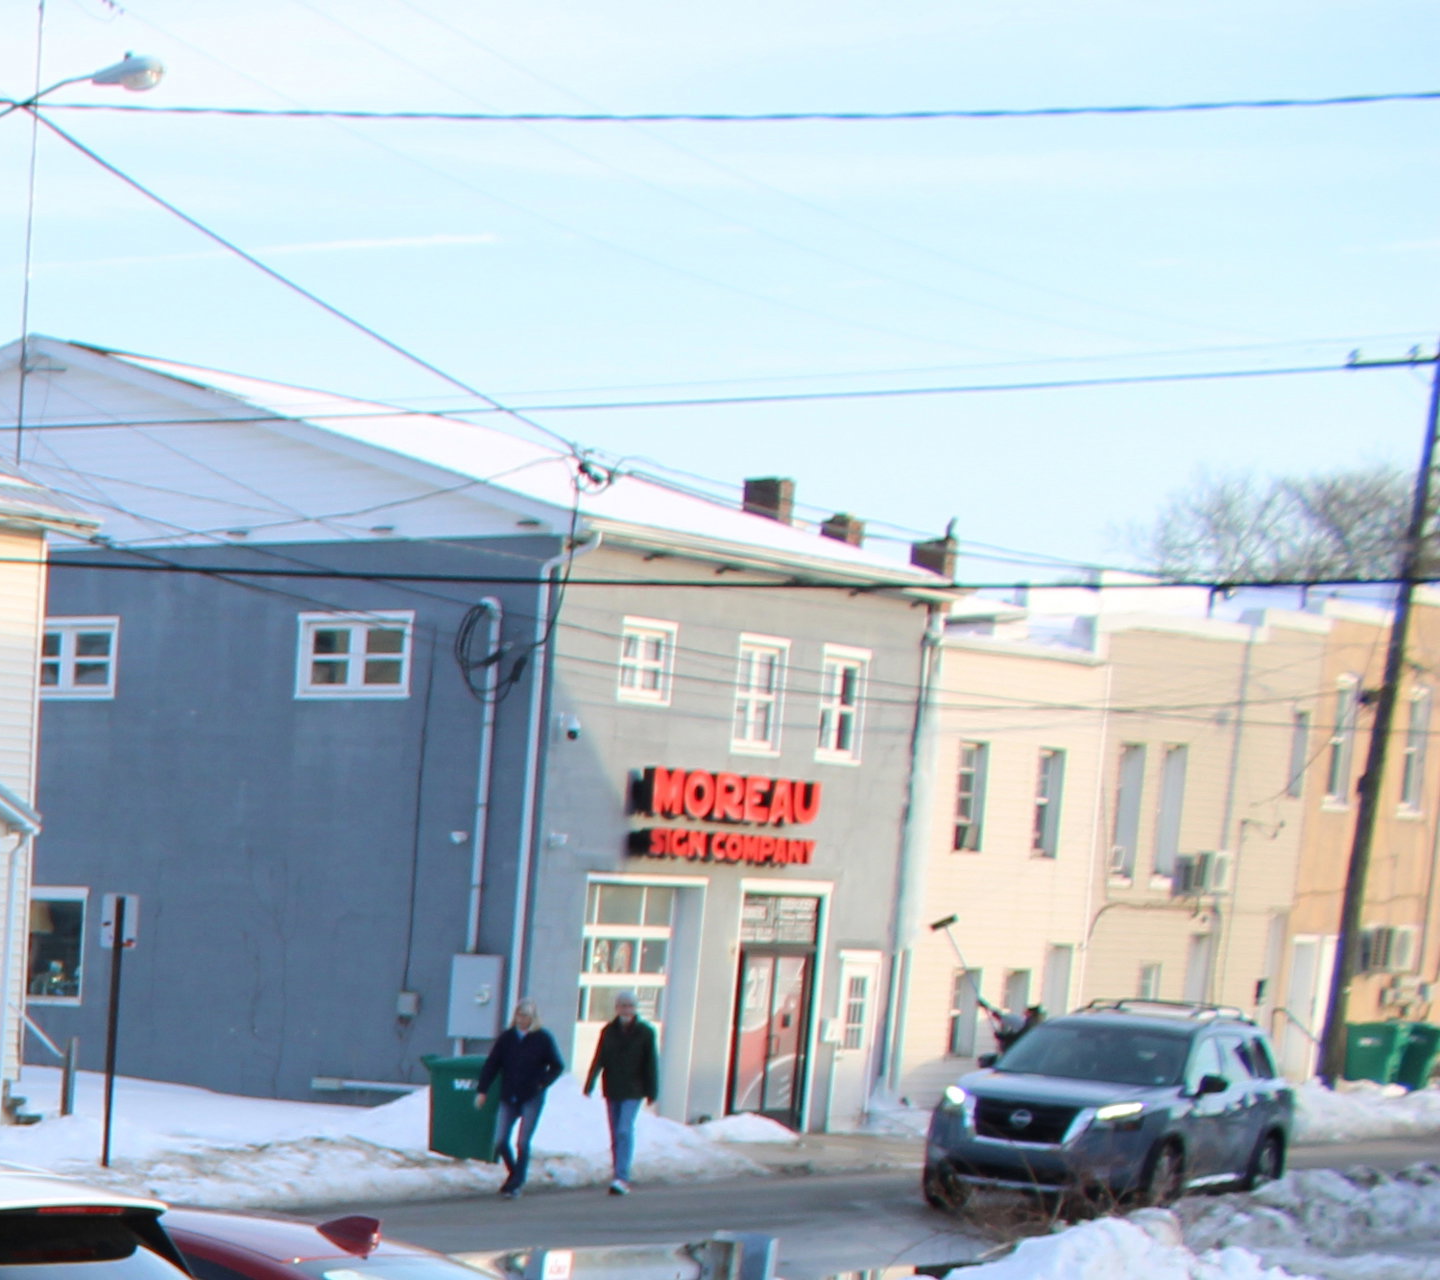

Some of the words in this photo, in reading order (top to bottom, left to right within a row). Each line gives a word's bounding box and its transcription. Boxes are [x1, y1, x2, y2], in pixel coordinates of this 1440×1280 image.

[652, 765, 822, 824] MOREAU
[648, 826, 707, 857] SIGN
[711, 831, 816, 865] COMPANY
